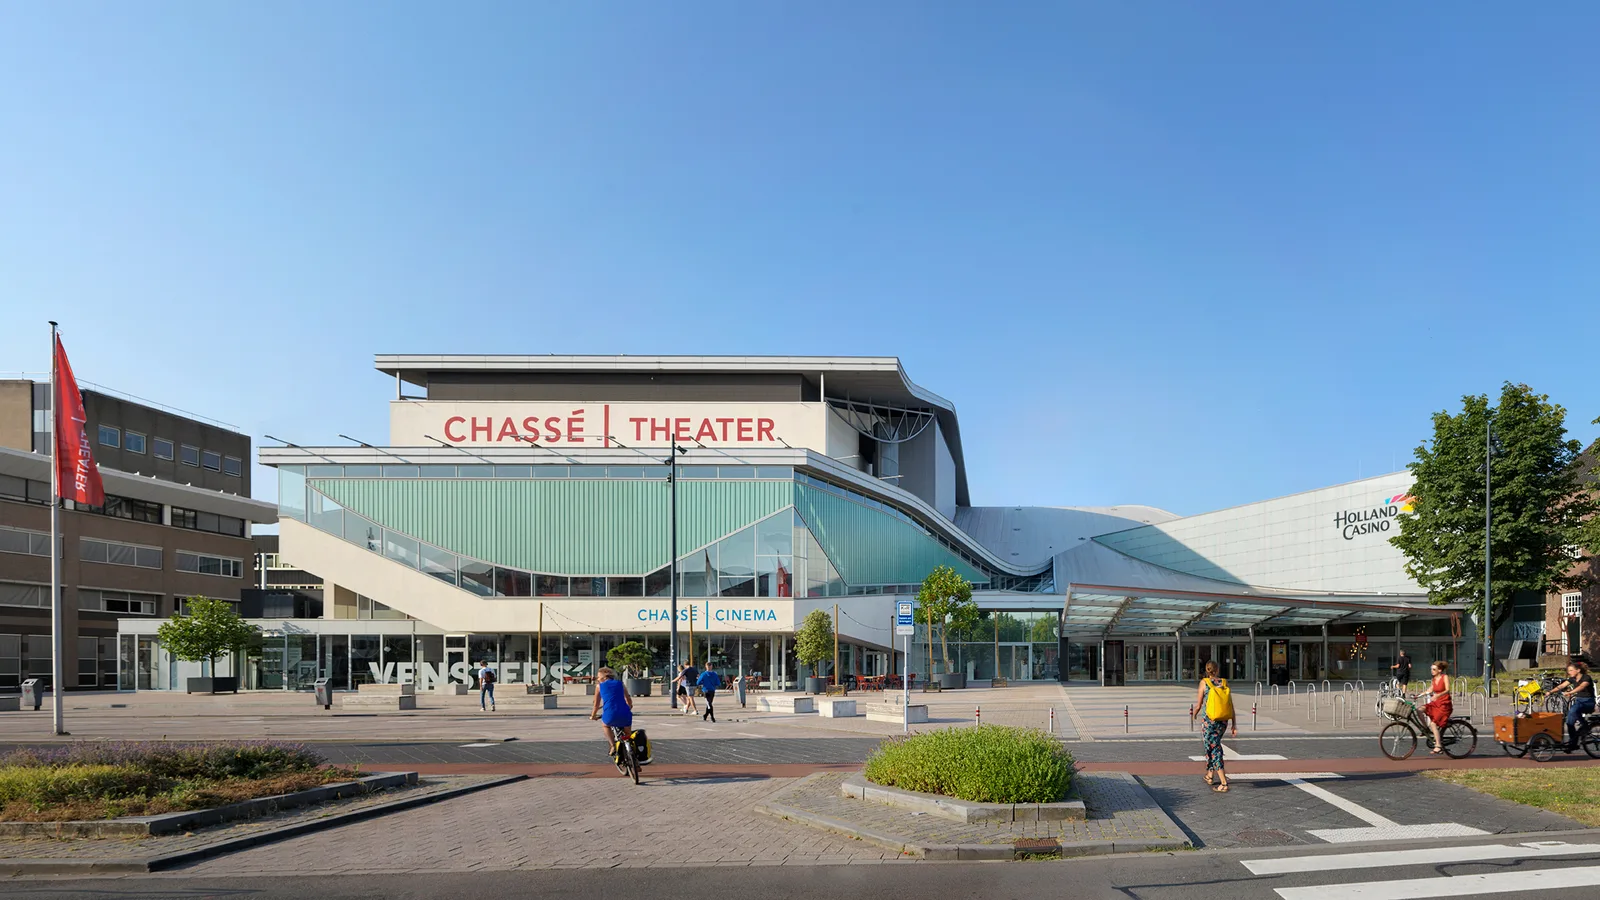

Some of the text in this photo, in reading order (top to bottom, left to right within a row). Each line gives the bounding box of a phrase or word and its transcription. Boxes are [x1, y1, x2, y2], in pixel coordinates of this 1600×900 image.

[444, 409, 775, 442] CHASSÉ THEATER
[1333, 505, 1398, 529] HOLLAND
[1343, 520, 1390, 540] CASINO
[637, 605, 777, 621] CHASÉ CINEMA
